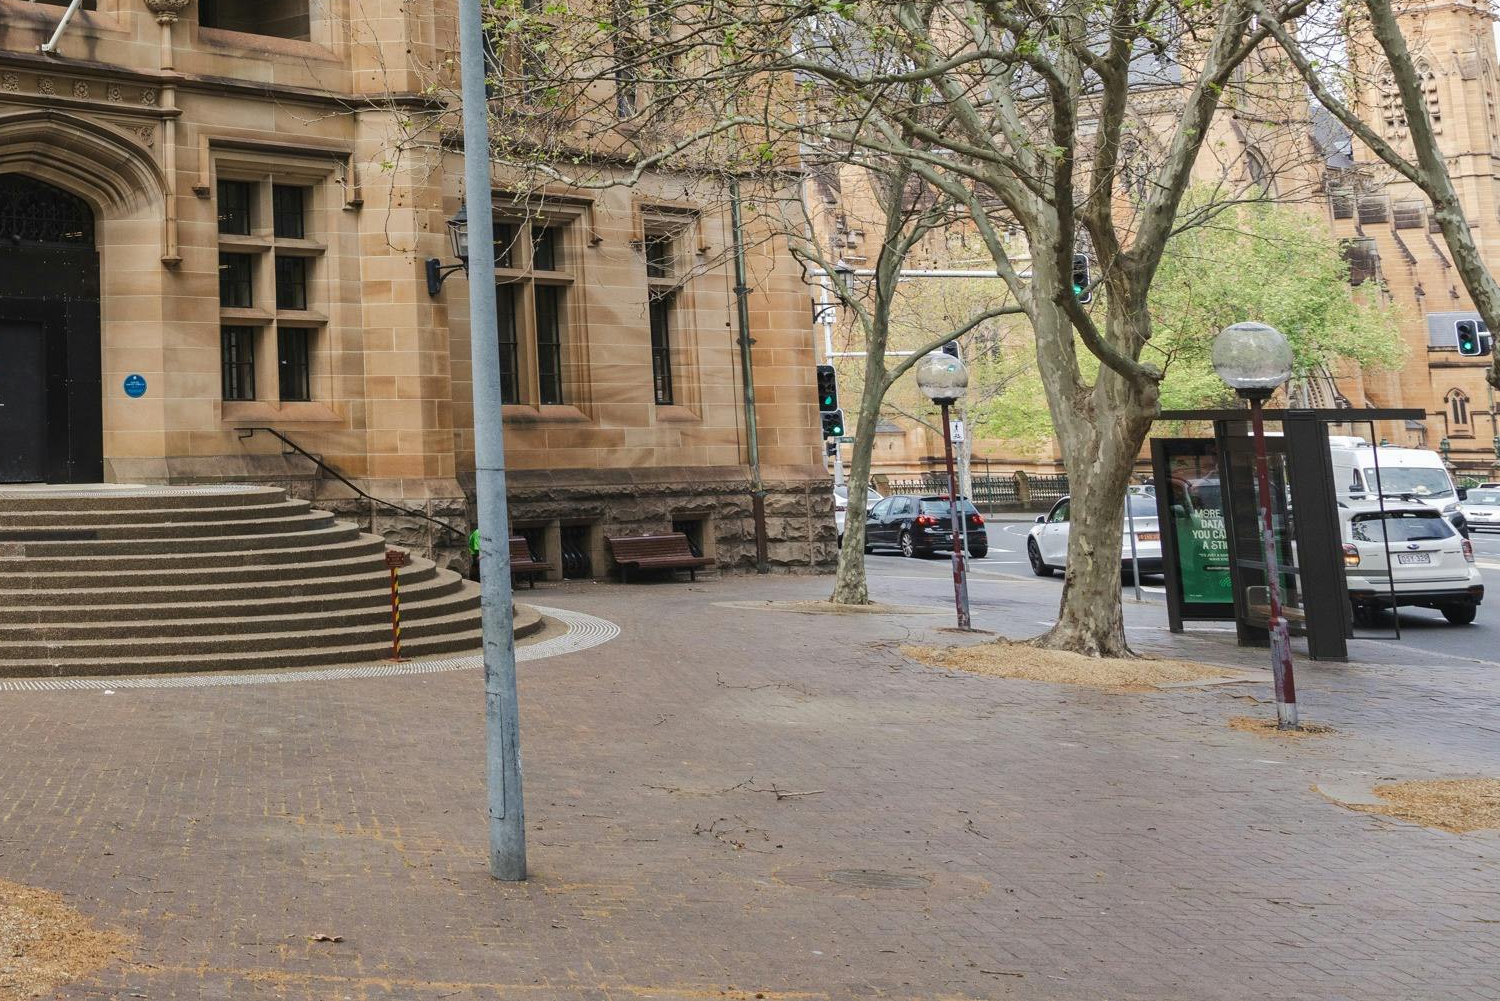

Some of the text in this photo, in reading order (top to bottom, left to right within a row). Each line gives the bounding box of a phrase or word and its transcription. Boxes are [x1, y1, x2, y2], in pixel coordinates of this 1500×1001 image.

[1194, 508, 1221, 518] MORE
[1200, 519, 1224, 529] DATA
[1192, 529, 1211, 539] YOU
[1202, 540, 1209, 550] A
